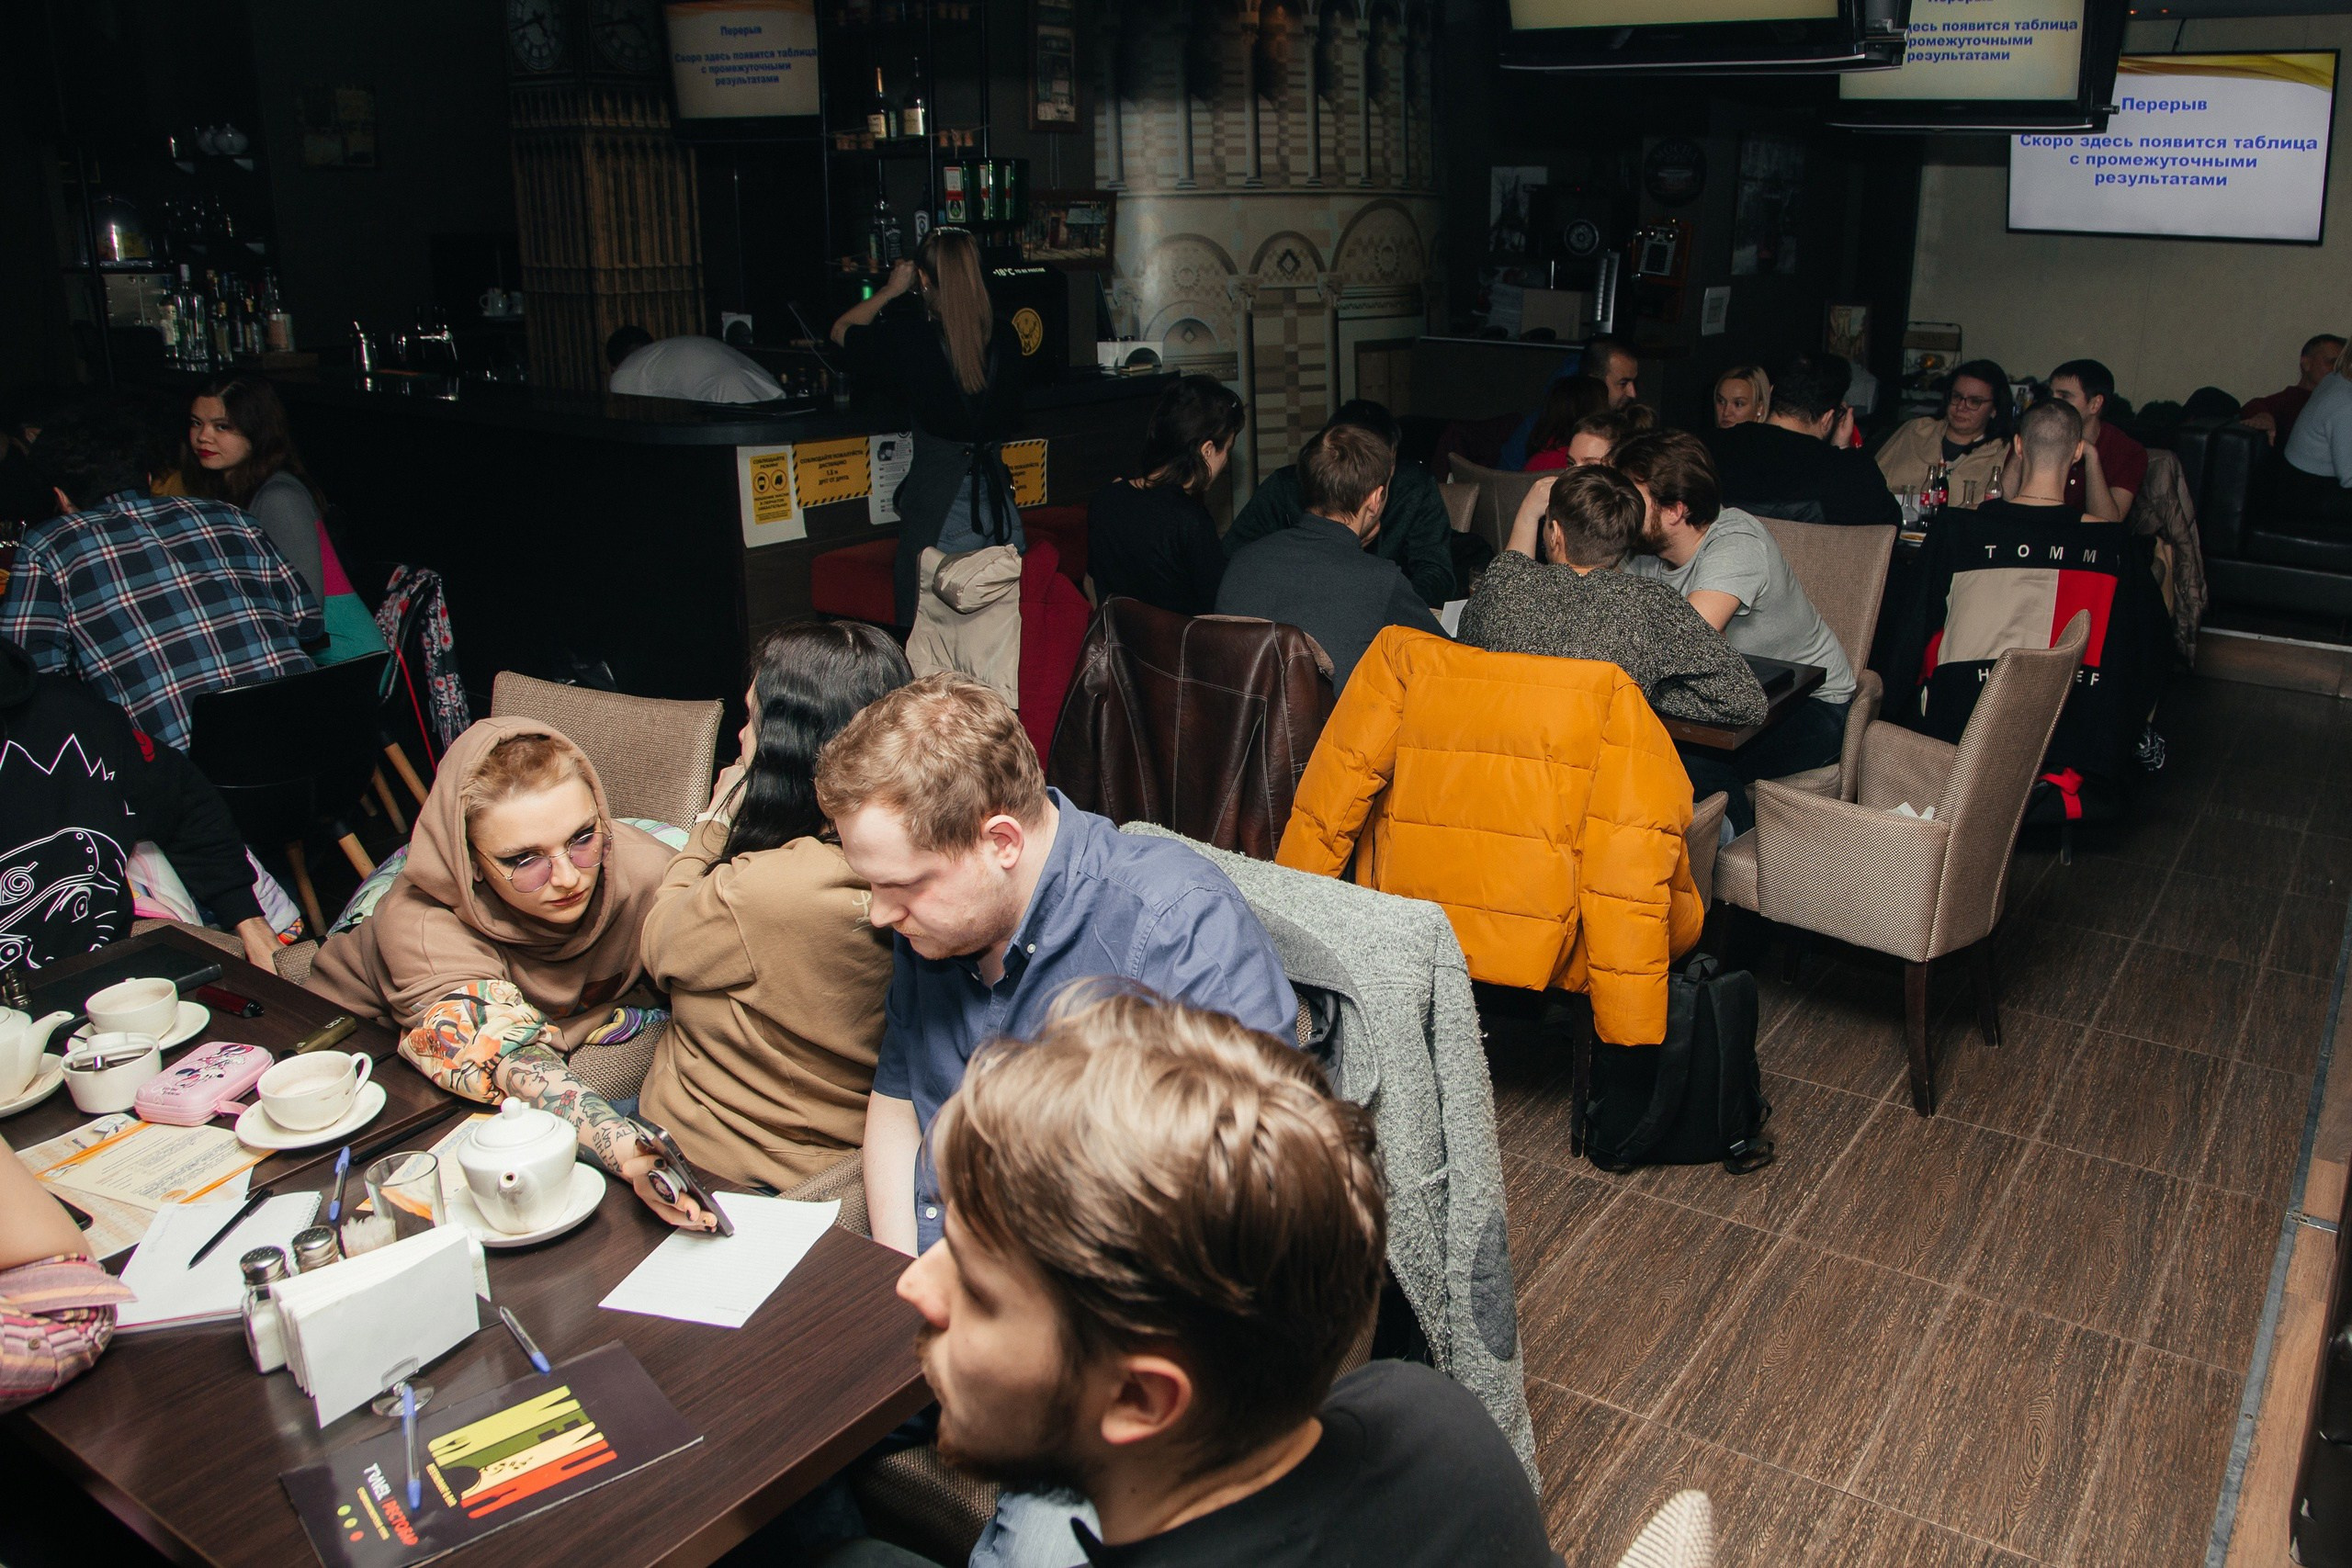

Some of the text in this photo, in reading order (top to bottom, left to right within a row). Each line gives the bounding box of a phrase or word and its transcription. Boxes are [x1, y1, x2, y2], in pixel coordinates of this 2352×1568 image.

[719, 26, 762, 37] Перерыв
[1908, 18, 2078, 33] есь появится таблица
[1907, 36, 2033, 50] ромежуточными
[674, 47, 817, 63] Скоро здесь появится таблица
[1906, 51, 2010, 63] результатами
[708, 62, 791, 74] промежуточными
[715, 75, 779, 87] результатами
[2121, 96, 2208, 114] Перерыв
[2019, 134, 2318, 152] Скоро здесь появится таблица
[2070, 154, 2257, 170] с промежуточными
[2095, 172, 2228, 186] результатами
[1984, 544, 2120, 568] TOMM
